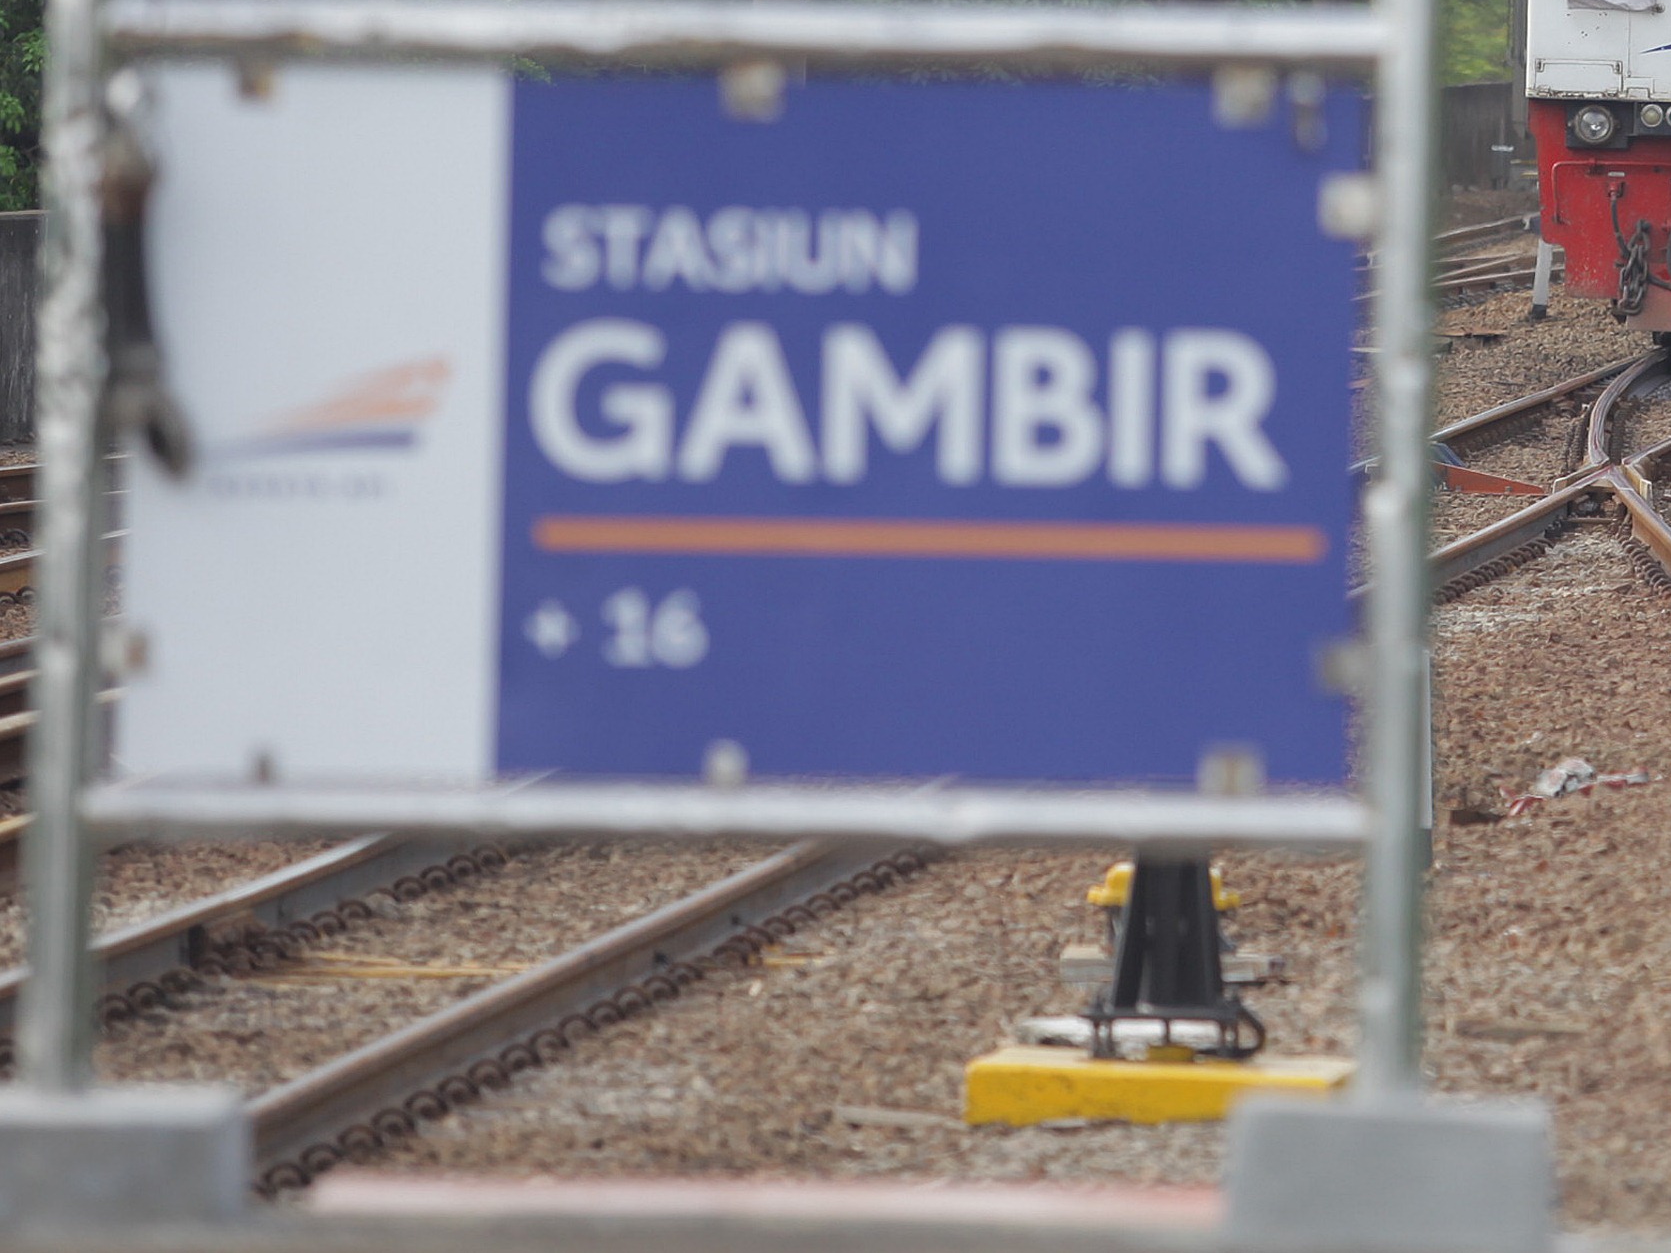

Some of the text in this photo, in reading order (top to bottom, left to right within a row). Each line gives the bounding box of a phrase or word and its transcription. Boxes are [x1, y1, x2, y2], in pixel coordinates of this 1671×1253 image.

[541, 204, 919, 295] STASIUN
[528, 318, 1288, 491] GAMBIR
[602, 587, 709, 668] 16
